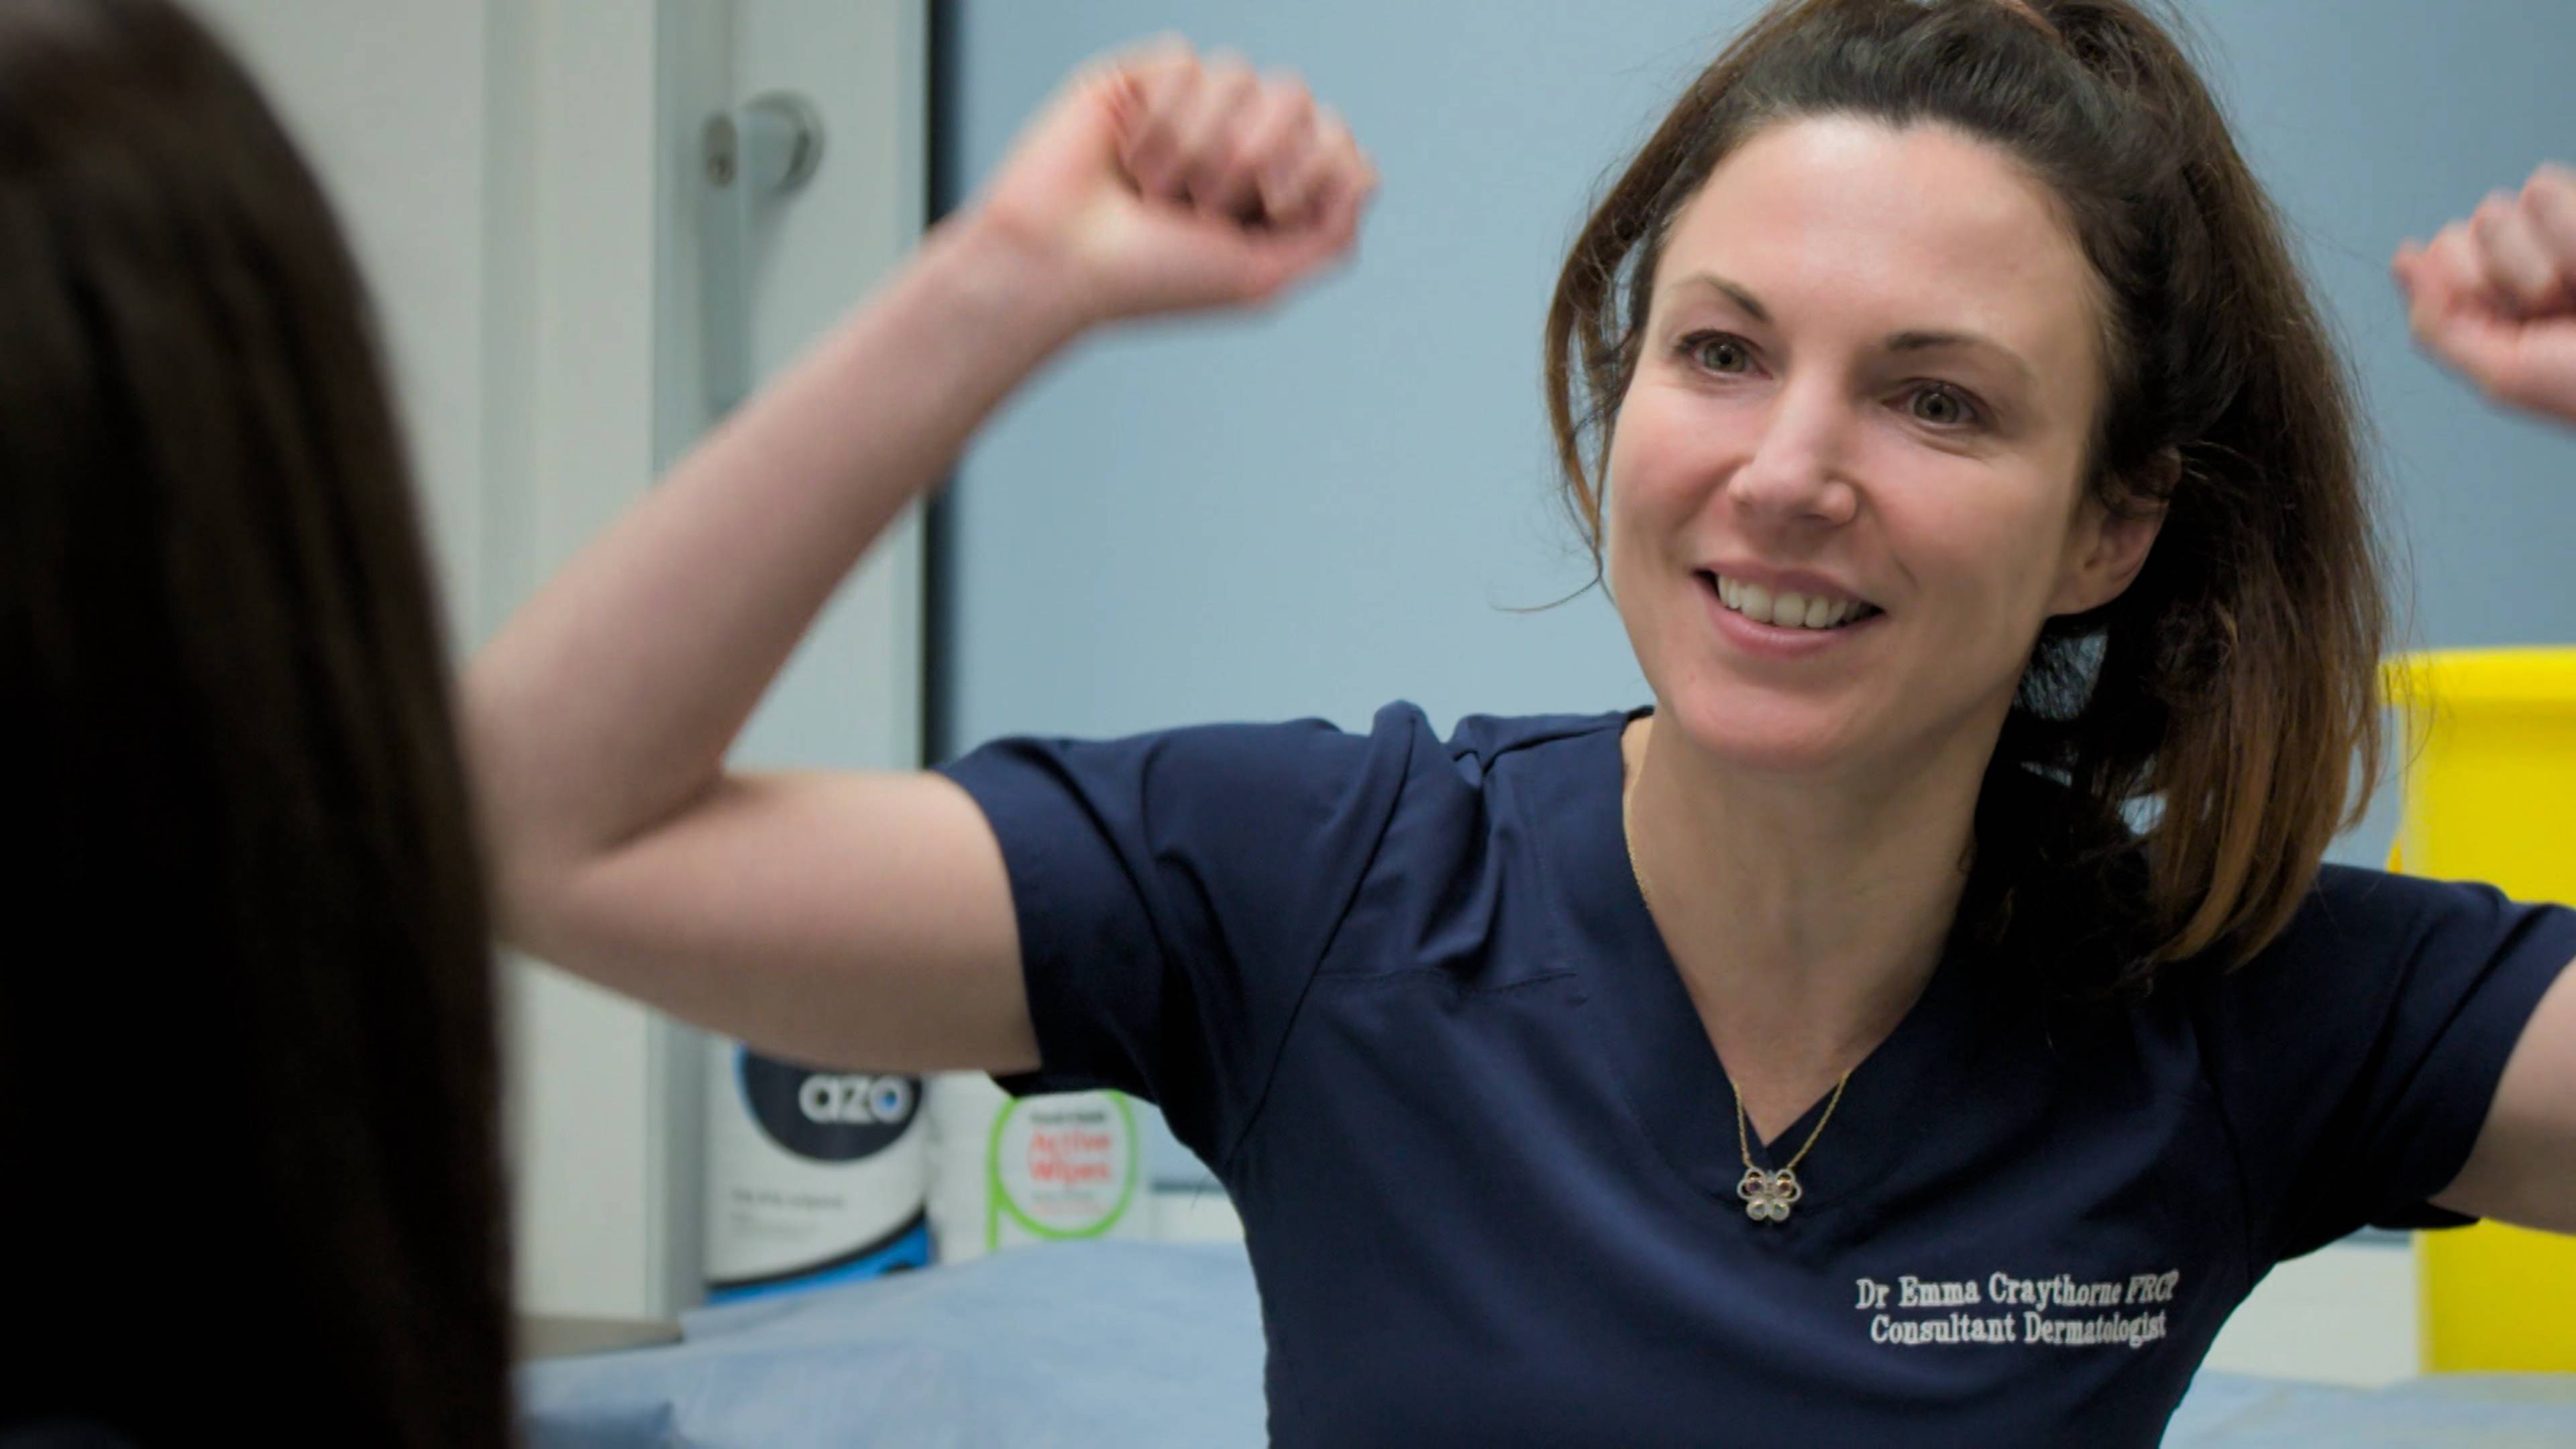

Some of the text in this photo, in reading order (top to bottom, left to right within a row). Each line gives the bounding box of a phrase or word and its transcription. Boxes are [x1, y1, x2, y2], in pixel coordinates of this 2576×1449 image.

[799, 1075, 912, 1124] azo
[1030, 1132, 1112, 1151] Active
[1029, 1163, 1111, 1185] Wipes
[1856, 1270, 2179, 1311] Dr Emma Craythorne FRCP
[1871, 1309, 2167, 1348] Consultant Dermatologist
